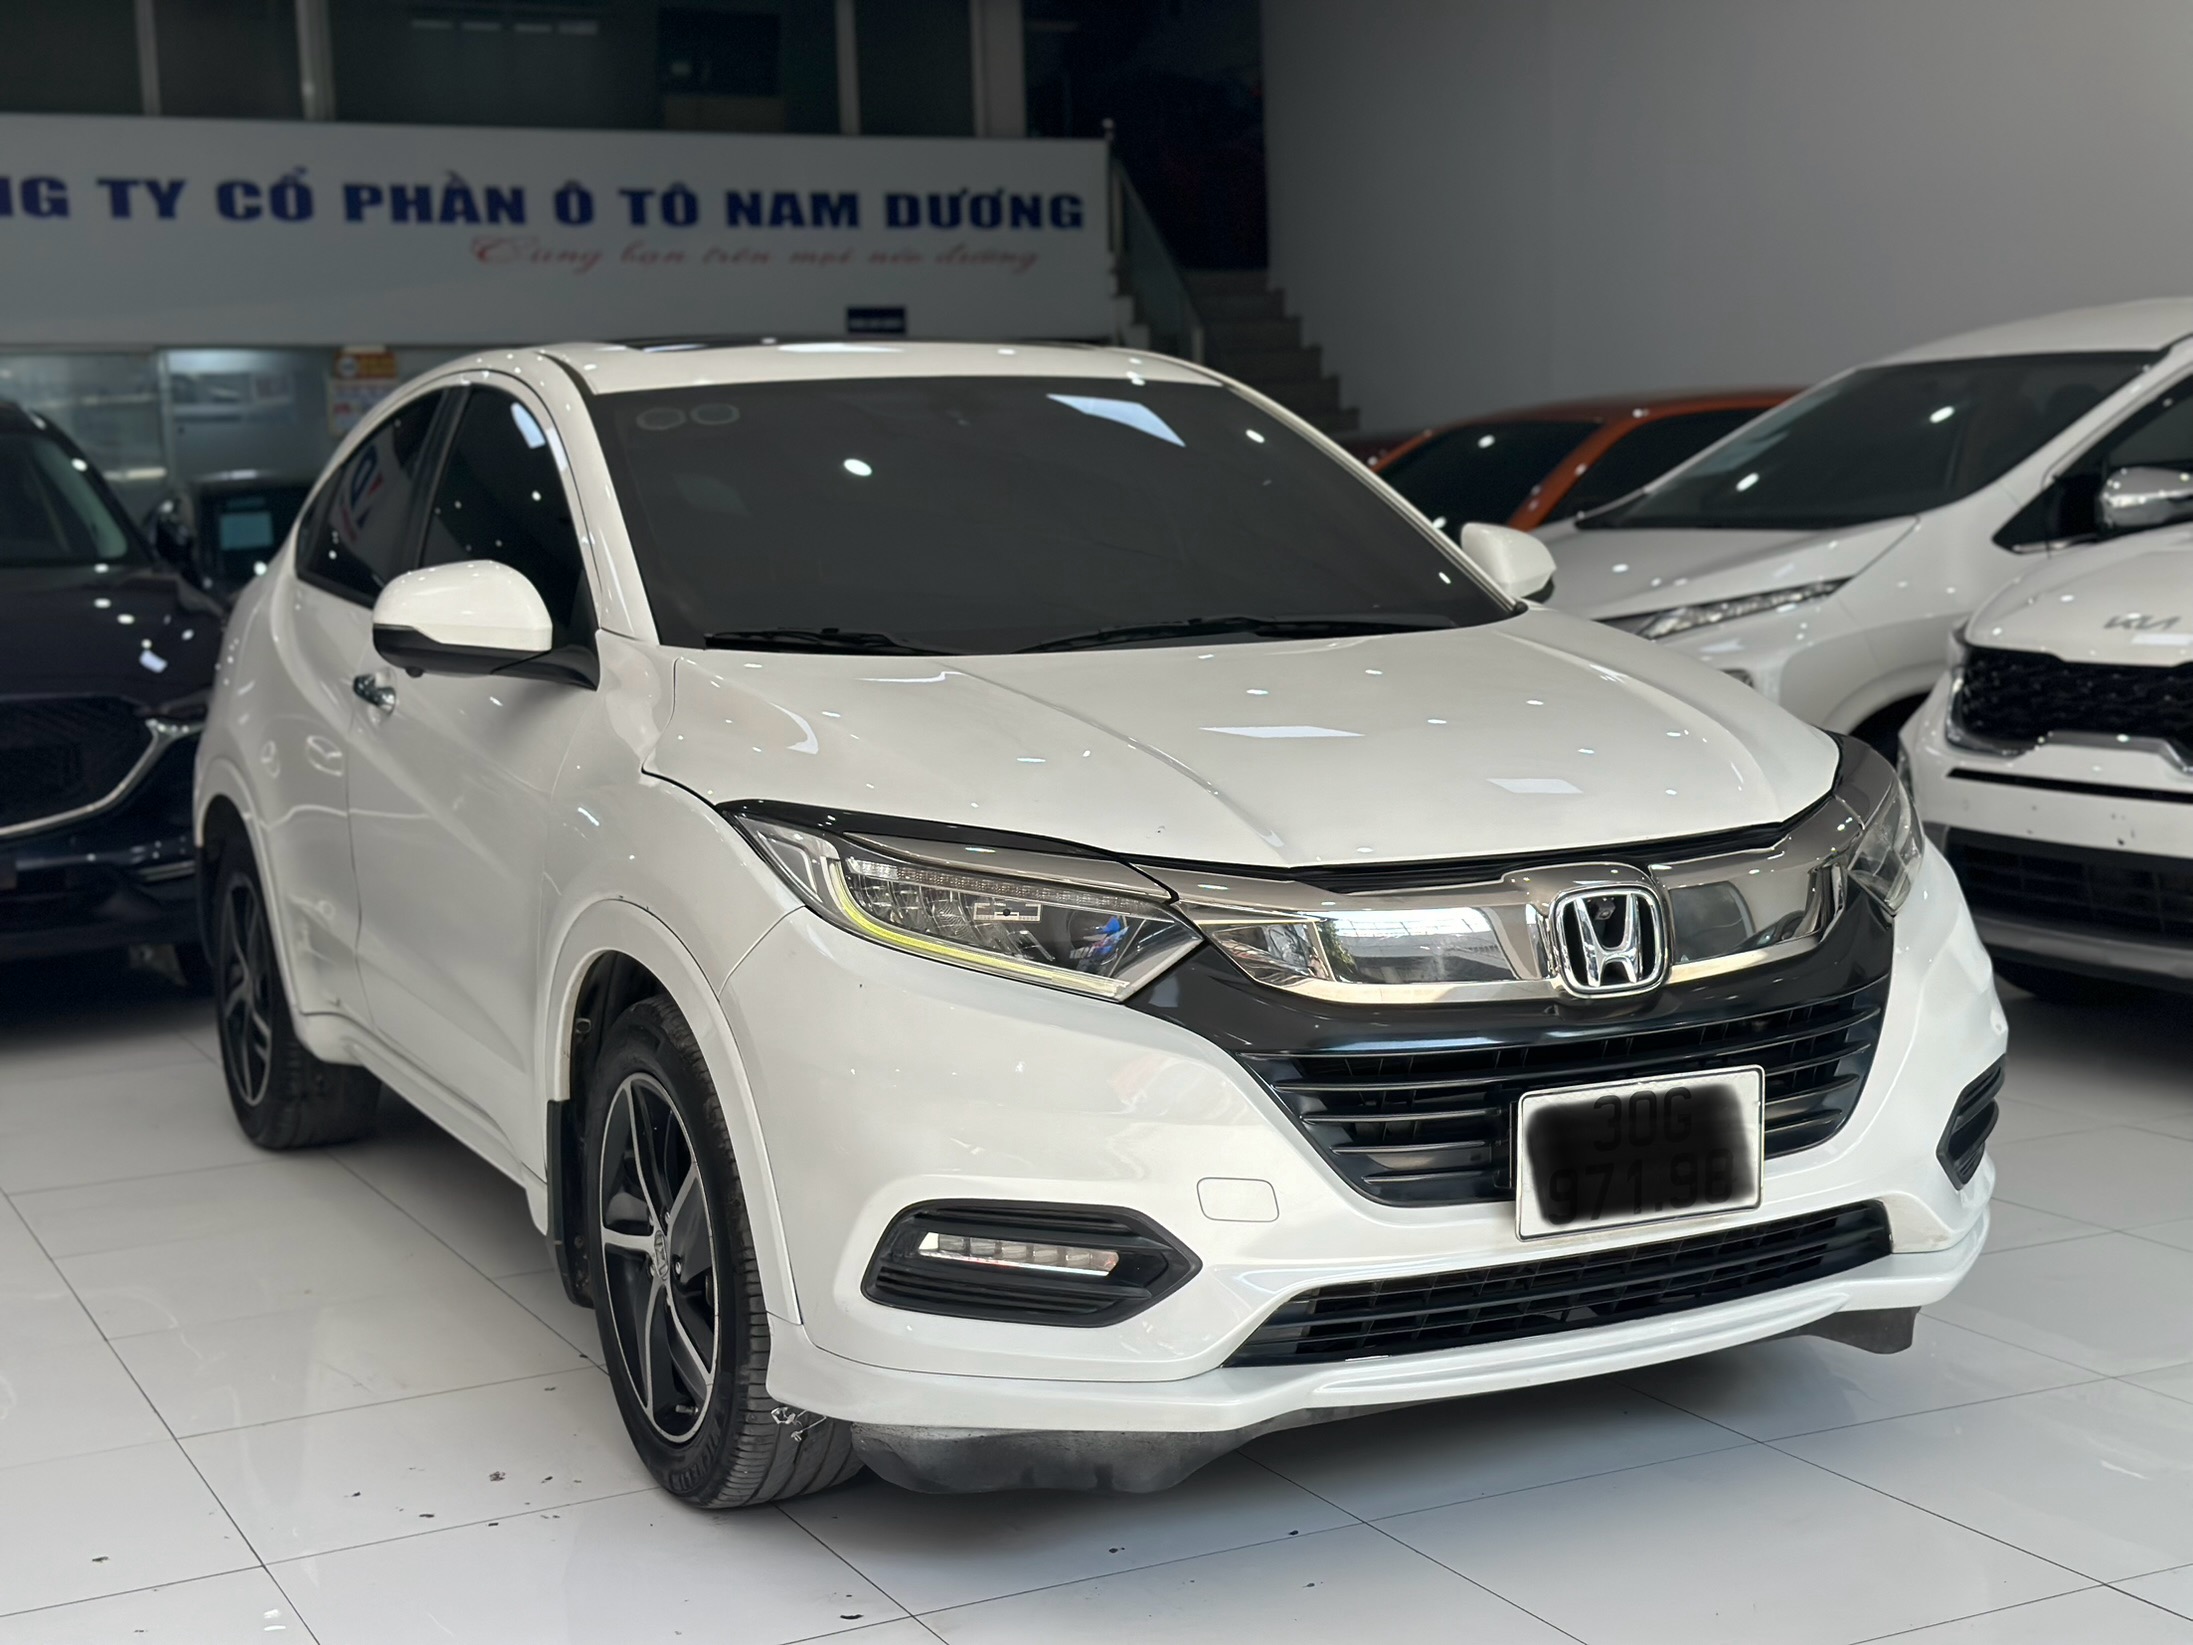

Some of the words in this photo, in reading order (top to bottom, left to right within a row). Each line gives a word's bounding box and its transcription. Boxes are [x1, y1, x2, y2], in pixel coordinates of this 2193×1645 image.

[97, 178, 186, 219] TY
[216, 167, 313, 221] CỔ
[343, 170, 525, 224] PHẦN
[554, 180, 594, 225] Ô
[619, 181, 699, 226] TÔ
[726, 191, 859, 228] NAM
[885, 187, 1083, 229] DƯƠNG
